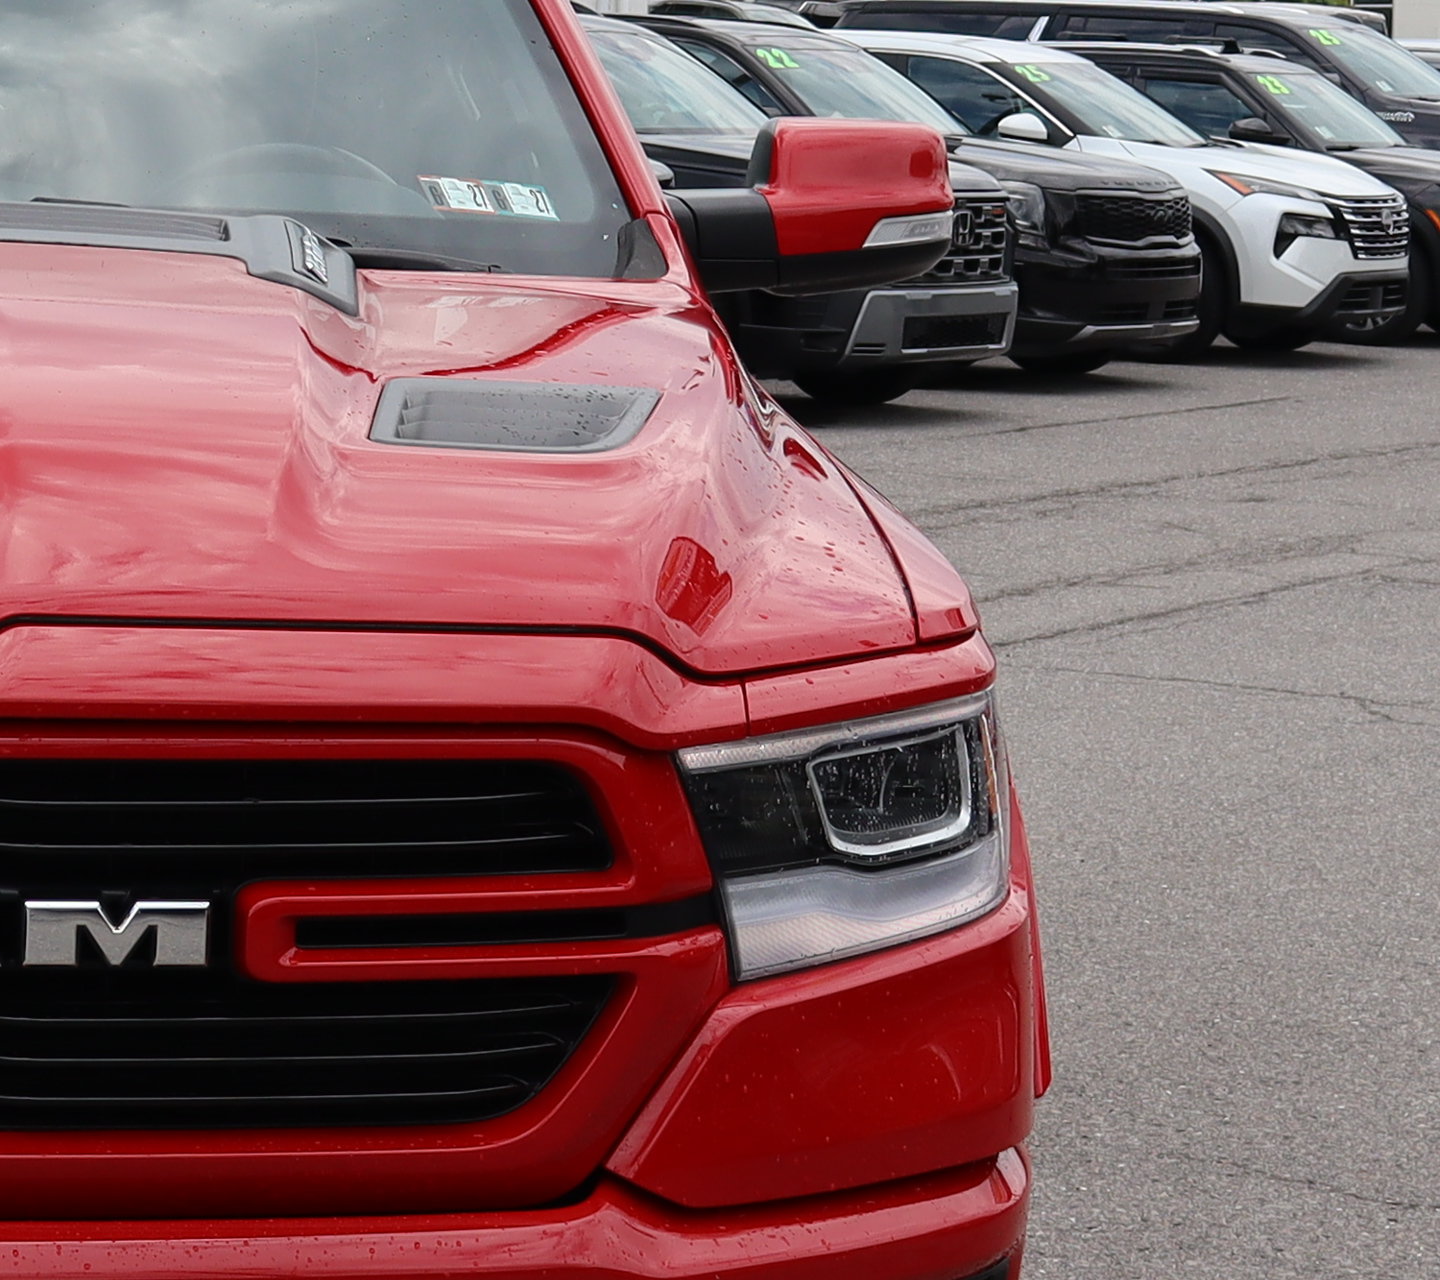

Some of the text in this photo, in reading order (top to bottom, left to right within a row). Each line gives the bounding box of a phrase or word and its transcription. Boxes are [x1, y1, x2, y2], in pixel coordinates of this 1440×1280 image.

[755, 48, 800, 68] 22
[466, 184, 488, 209] 27
[529, 189, 550, 215] 27
